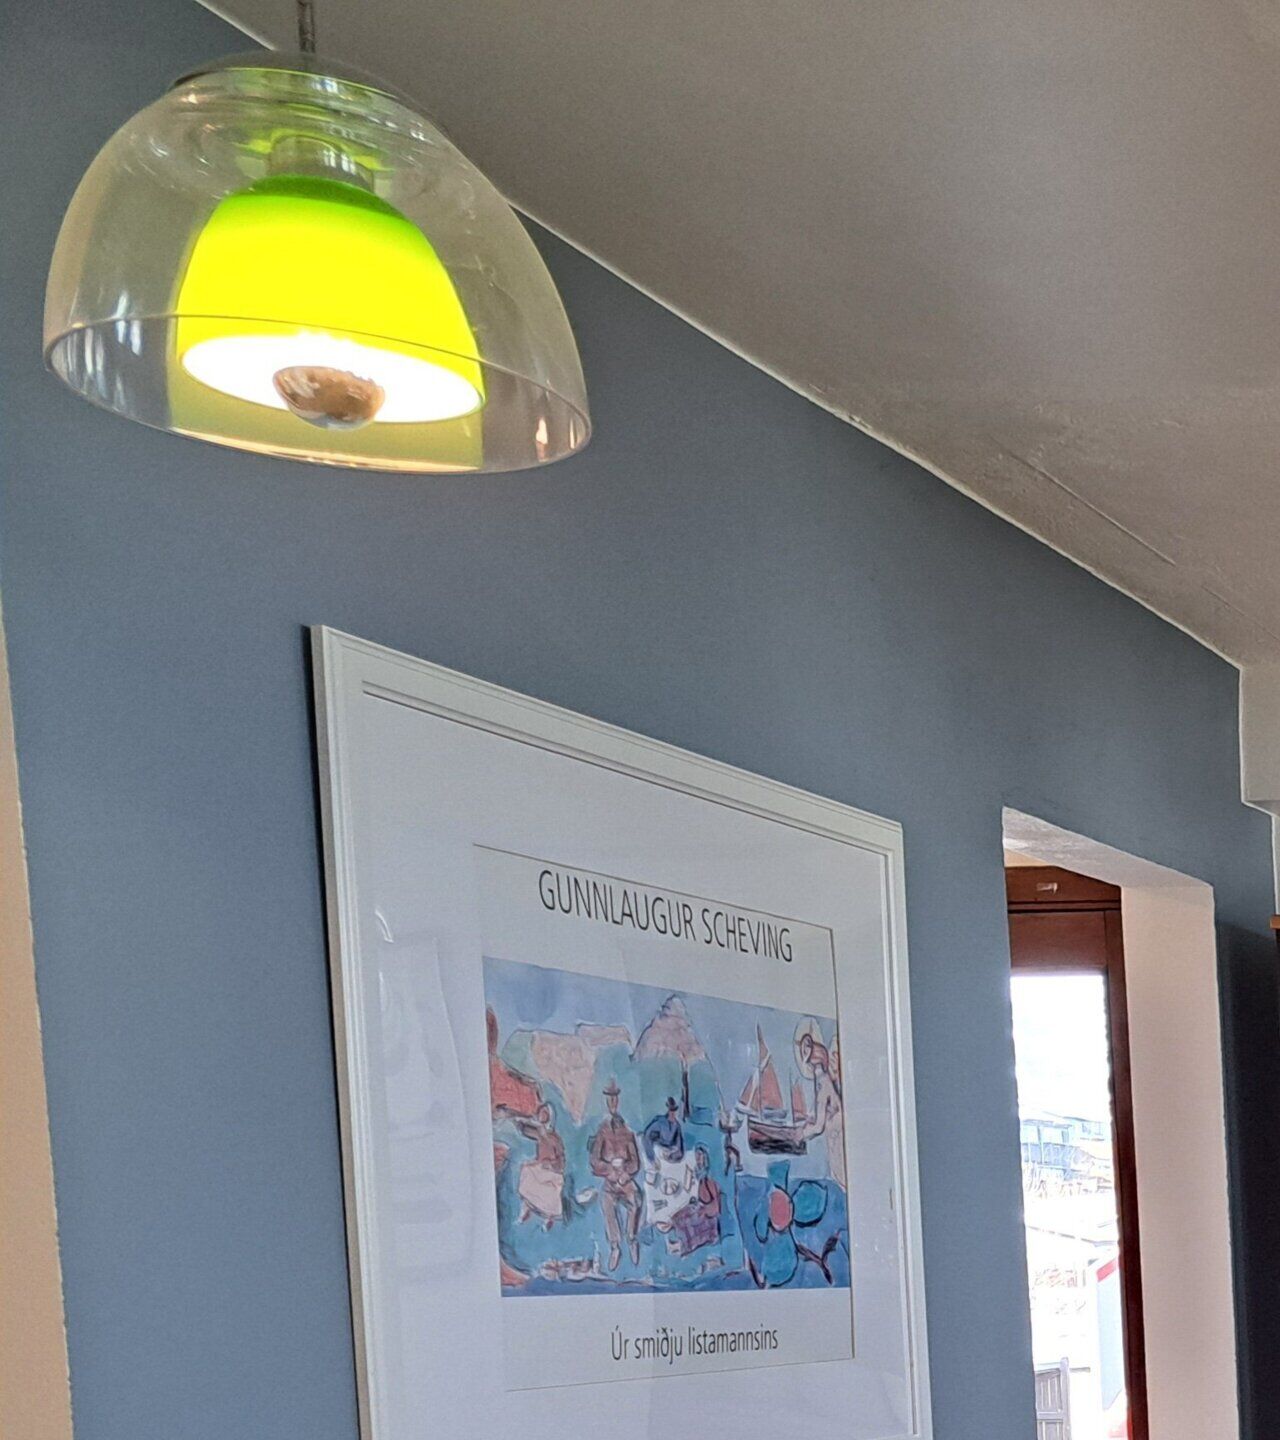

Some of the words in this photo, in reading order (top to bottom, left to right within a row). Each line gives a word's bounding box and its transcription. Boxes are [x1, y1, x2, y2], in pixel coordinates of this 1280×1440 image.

[538, 869, 697, 941] GUNNLAUGUR
[701, 908, 793, 962] SCHEVING
[611, 1325, 630, 1361] Úr
[634, 1327, 683, 1365] smiðju
[688, 1323, 778, 1356] listamannsins
